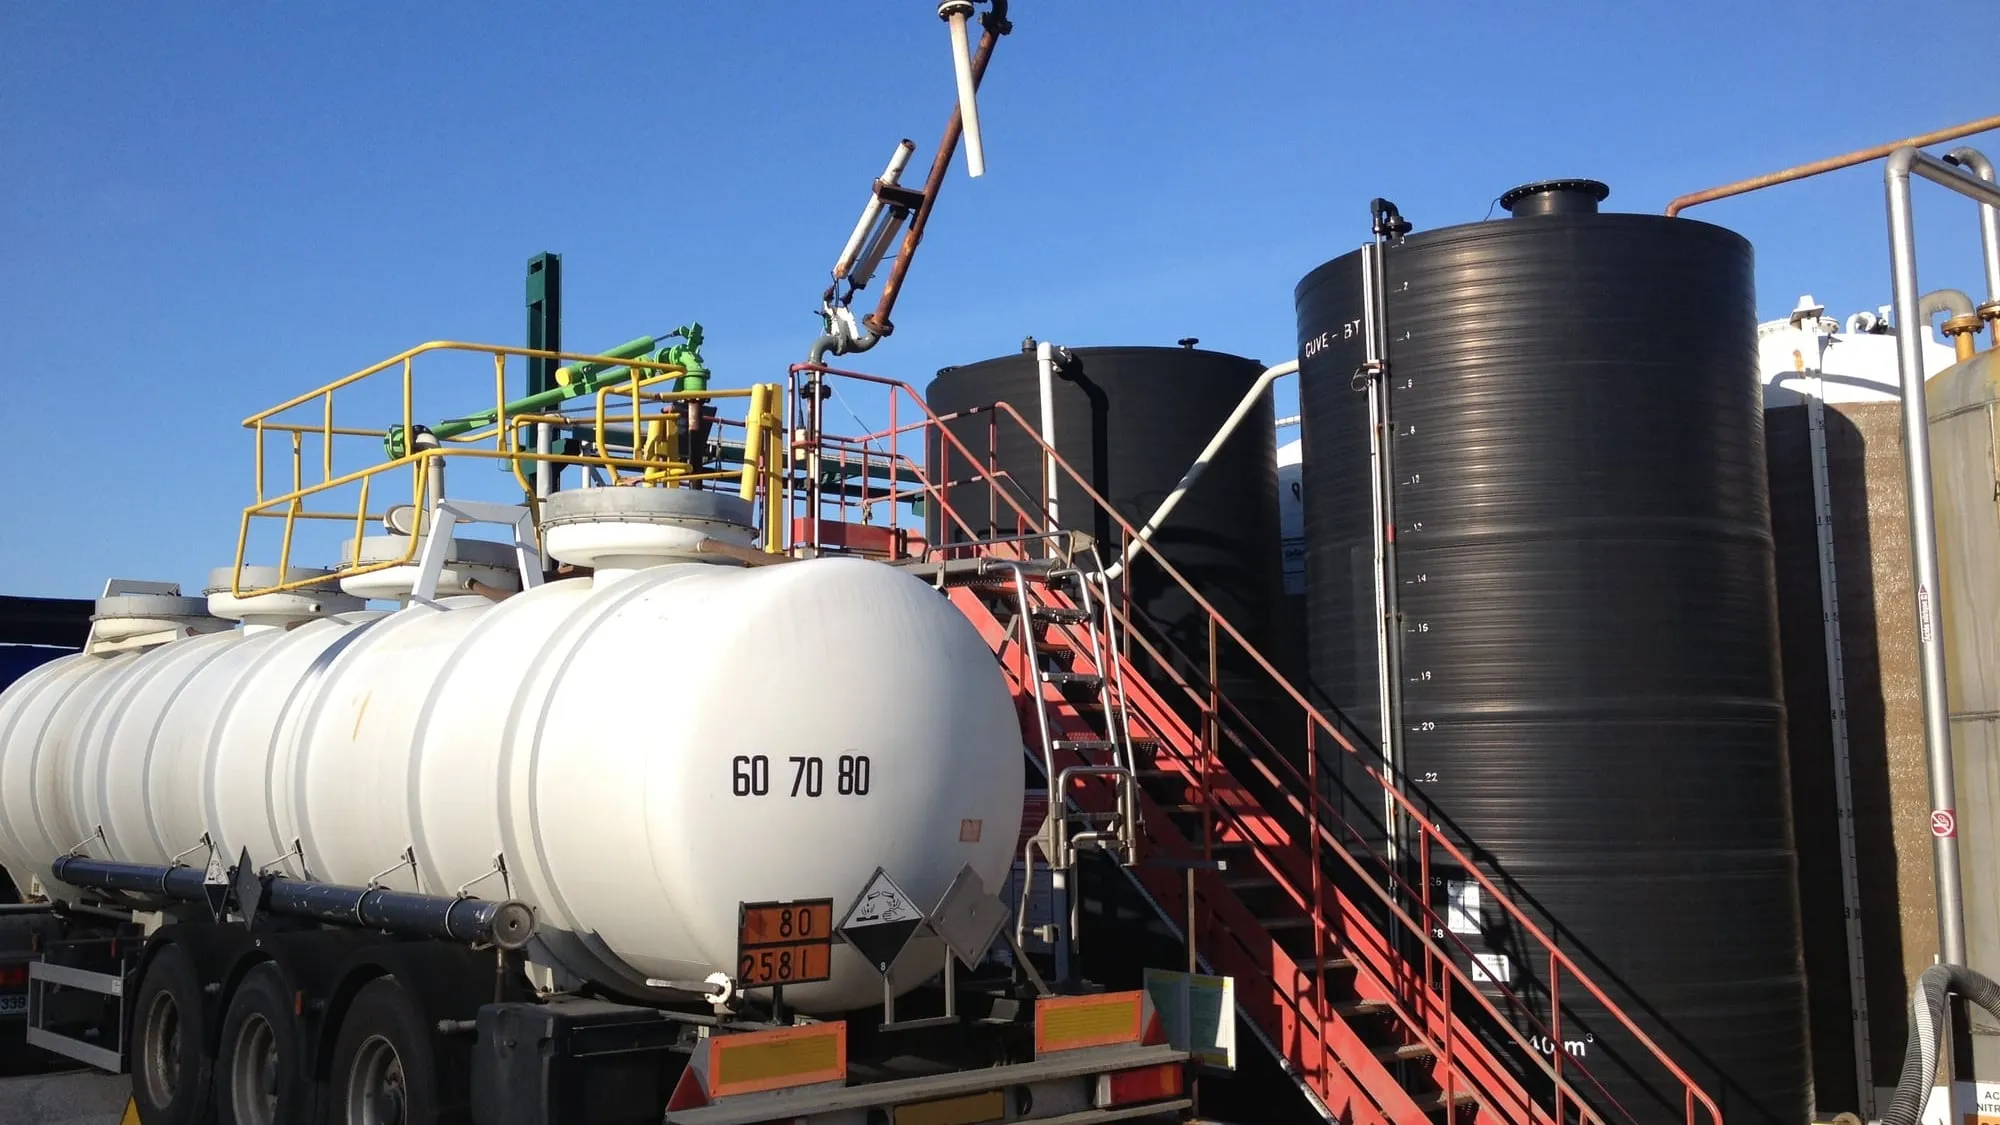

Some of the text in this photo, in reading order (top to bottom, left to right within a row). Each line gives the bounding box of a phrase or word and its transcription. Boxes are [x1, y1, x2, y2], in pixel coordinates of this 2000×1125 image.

[1305, 332, 1329, 358] CUVE
[1422, 722, 1435, 731] 20
[733, 754, 870, 798] 60 70 80
[1426, 772, 1438, 782] 22
[780, 908, 811, 937] 80
[742, 950, 806, 982] 2581
[880, 961, 886, 971] 8
